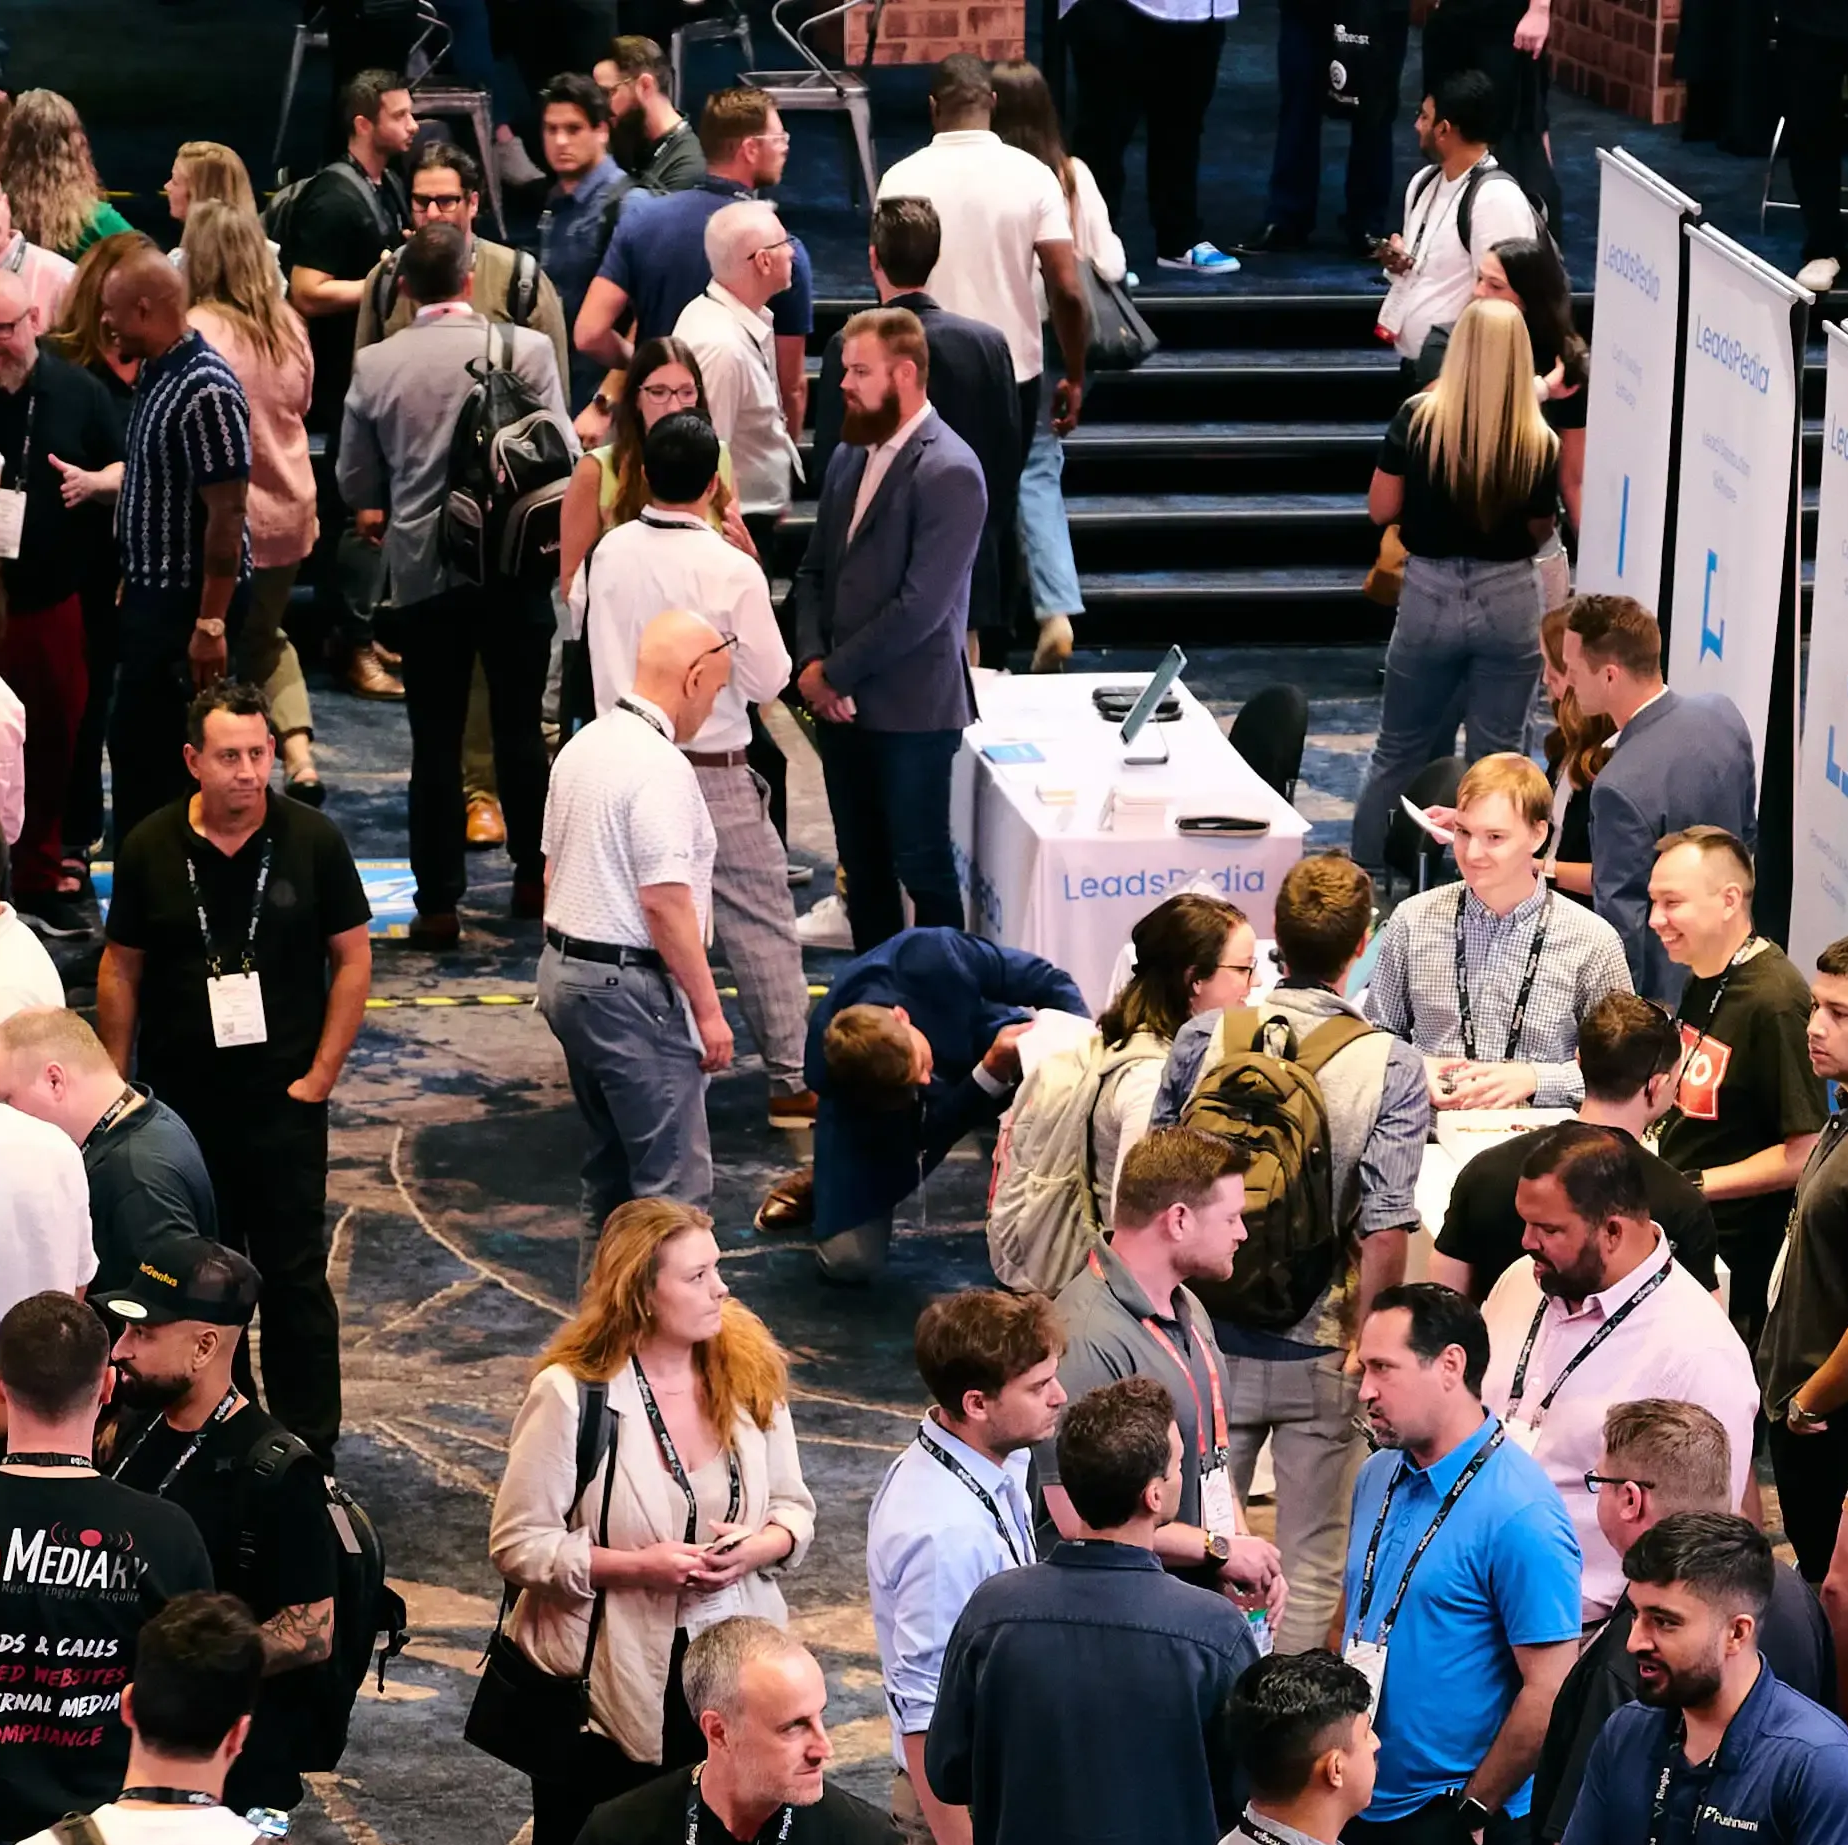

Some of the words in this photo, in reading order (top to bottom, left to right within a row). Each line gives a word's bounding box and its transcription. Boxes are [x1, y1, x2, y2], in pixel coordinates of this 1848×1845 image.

[1696, 314, 1770, 394] LeadsPedia
[1065, 866, 1265, 899] LeadsPdia
[1631, 1282, 1656, 1304] Ringba
[1589, 1324, 1613, 1347] Ringba
[1452, 1470, 1473, 1497] Ringba
[1418, 1524, 1438, 1552] Ringba
[35, 1637, 49, 1656] &
[57, 1636, 119, 1658] CALLS
[33, 1665, 127, 1687] WEBSITES
[58, 1692, 121, 1718] MEDIA
[1656, 1767, 1670, 1800] Ringba
[779, 1808, 792, 1841] Ringba
[1713, 1812, 1759, 1833] Pushnami
